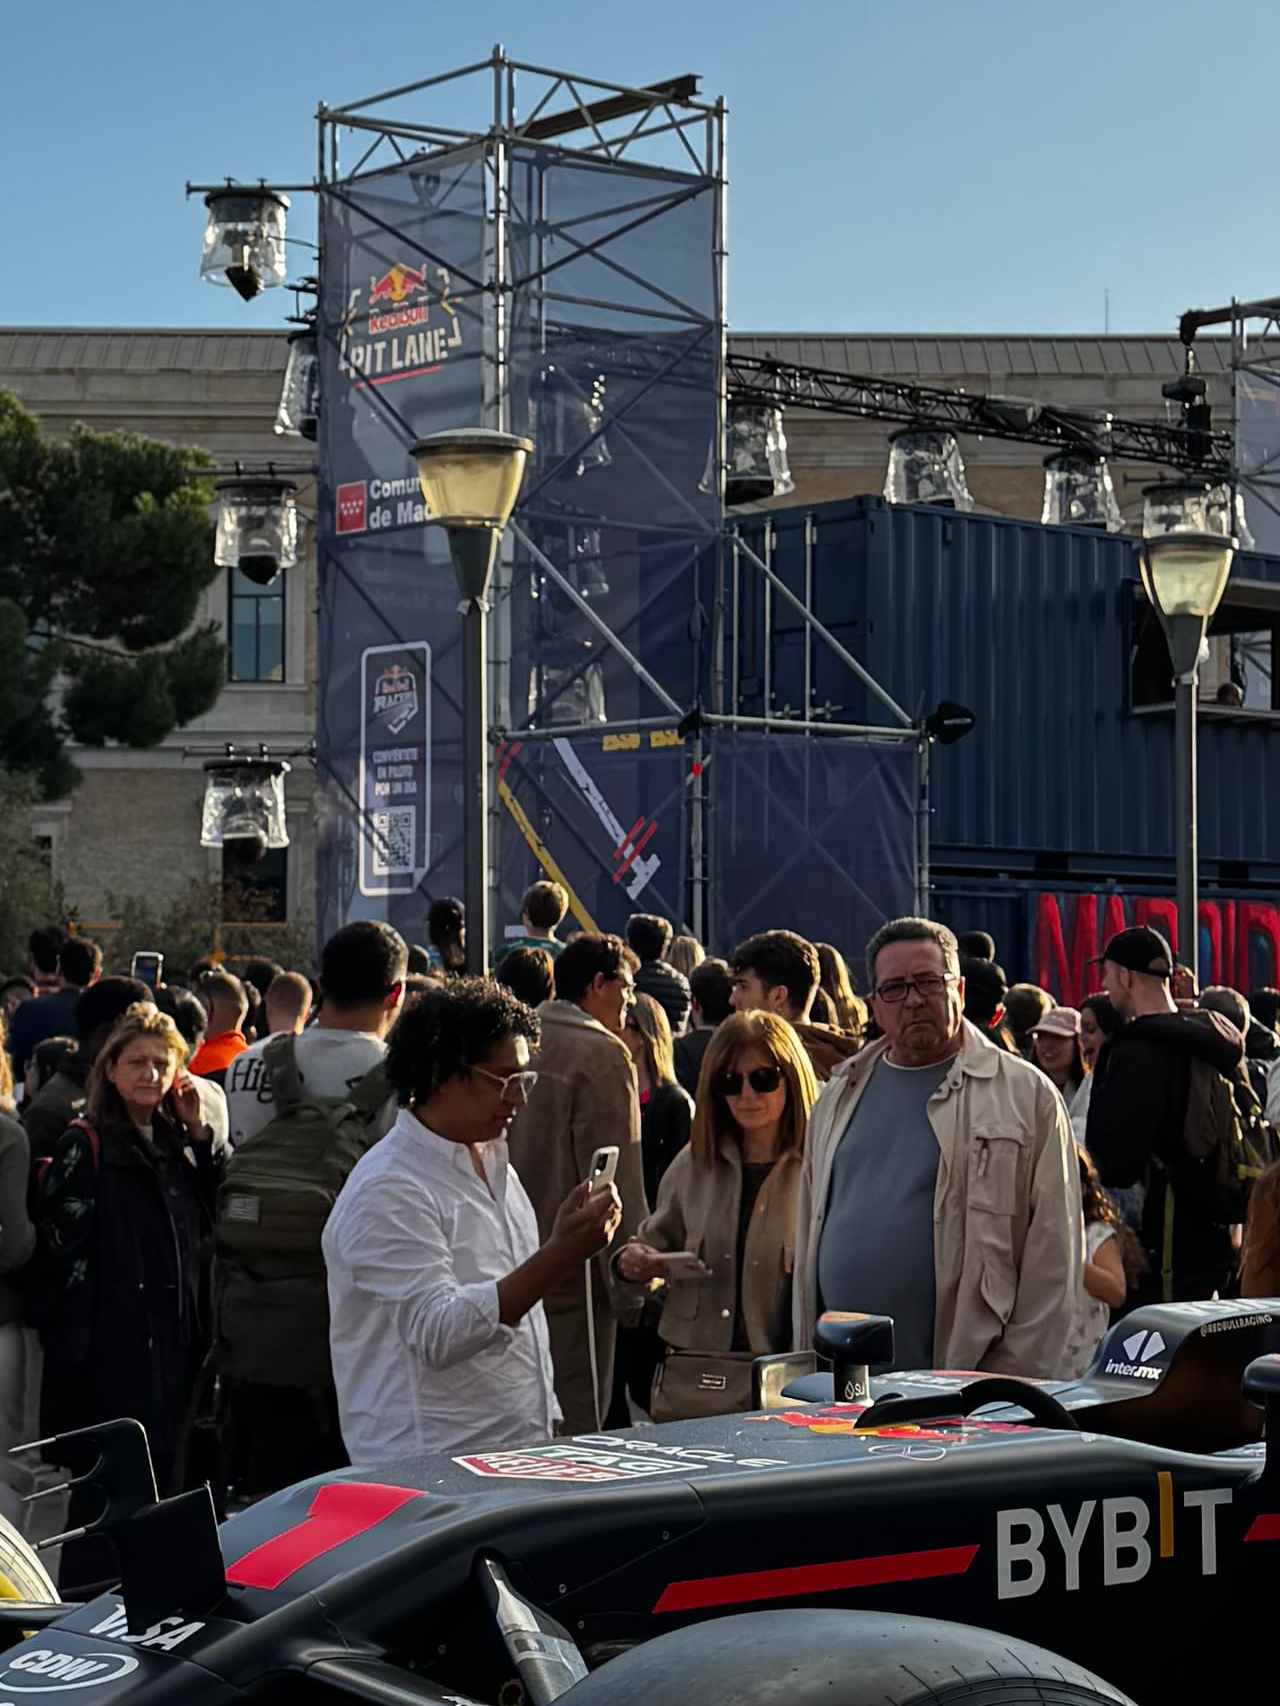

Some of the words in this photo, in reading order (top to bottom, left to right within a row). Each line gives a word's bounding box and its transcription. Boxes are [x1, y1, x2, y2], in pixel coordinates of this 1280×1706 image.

[350, 341, 387, 379] PIT
[392, 327, 448, 370] LANE
[370, 506, 395, 528] de
[1105, 1359, 1162, 1380] inter.mx
[543, 1446, 676, 1473] TAG
[572, 1435, 789, 1468] ORACLE
[479, 1453, 618, 1481] HEUER
[997, 1471, 1233, 1599] BYBIT
[10, 1649, 111, 1683] CDW
